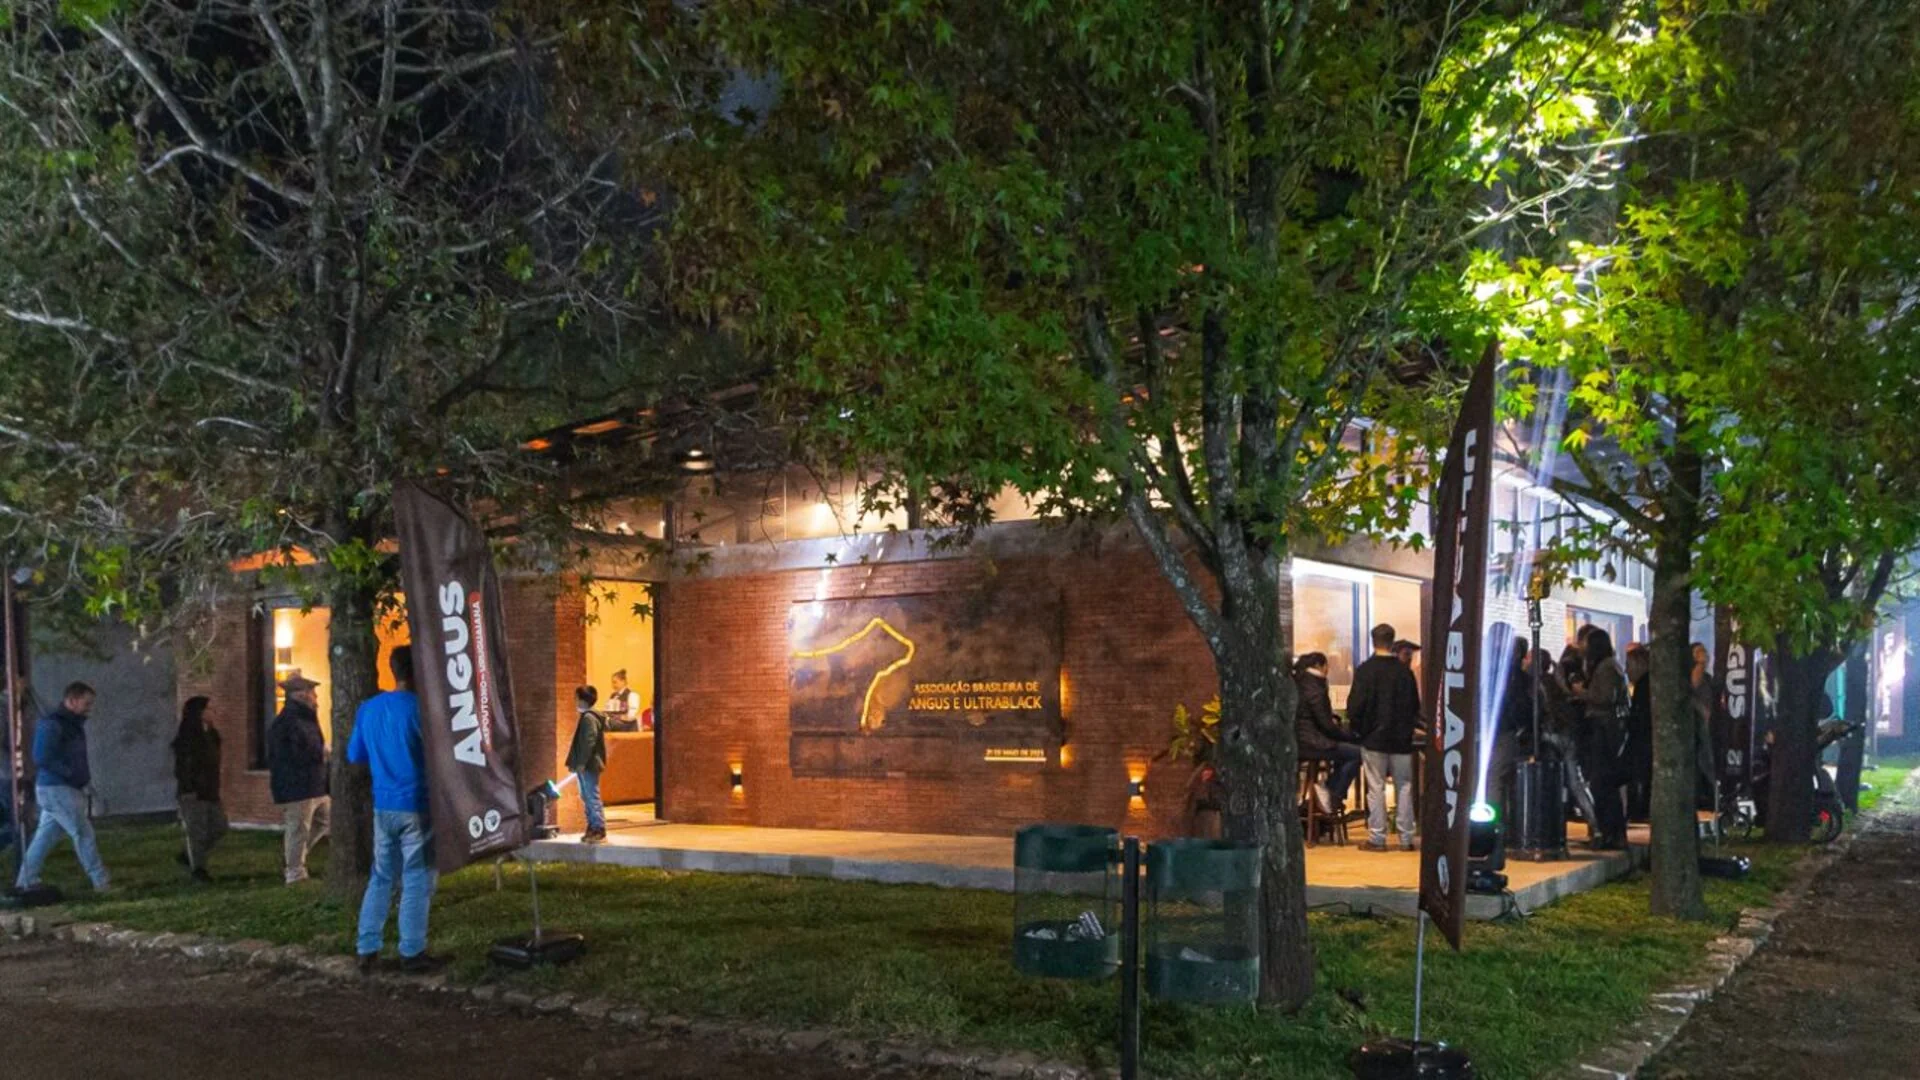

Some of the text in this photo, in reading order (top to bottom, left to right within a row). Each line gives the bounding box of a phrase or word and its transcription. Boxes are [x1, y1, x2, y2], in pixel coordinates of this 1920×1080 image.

[439, 580, 486, 767] ANGUS
[914, 681, 1039, 693] ASSOCIAÇÃO BRASILEIRA DE
[908, 695, 1042, 710] ANGUS E ULTRABLACK
